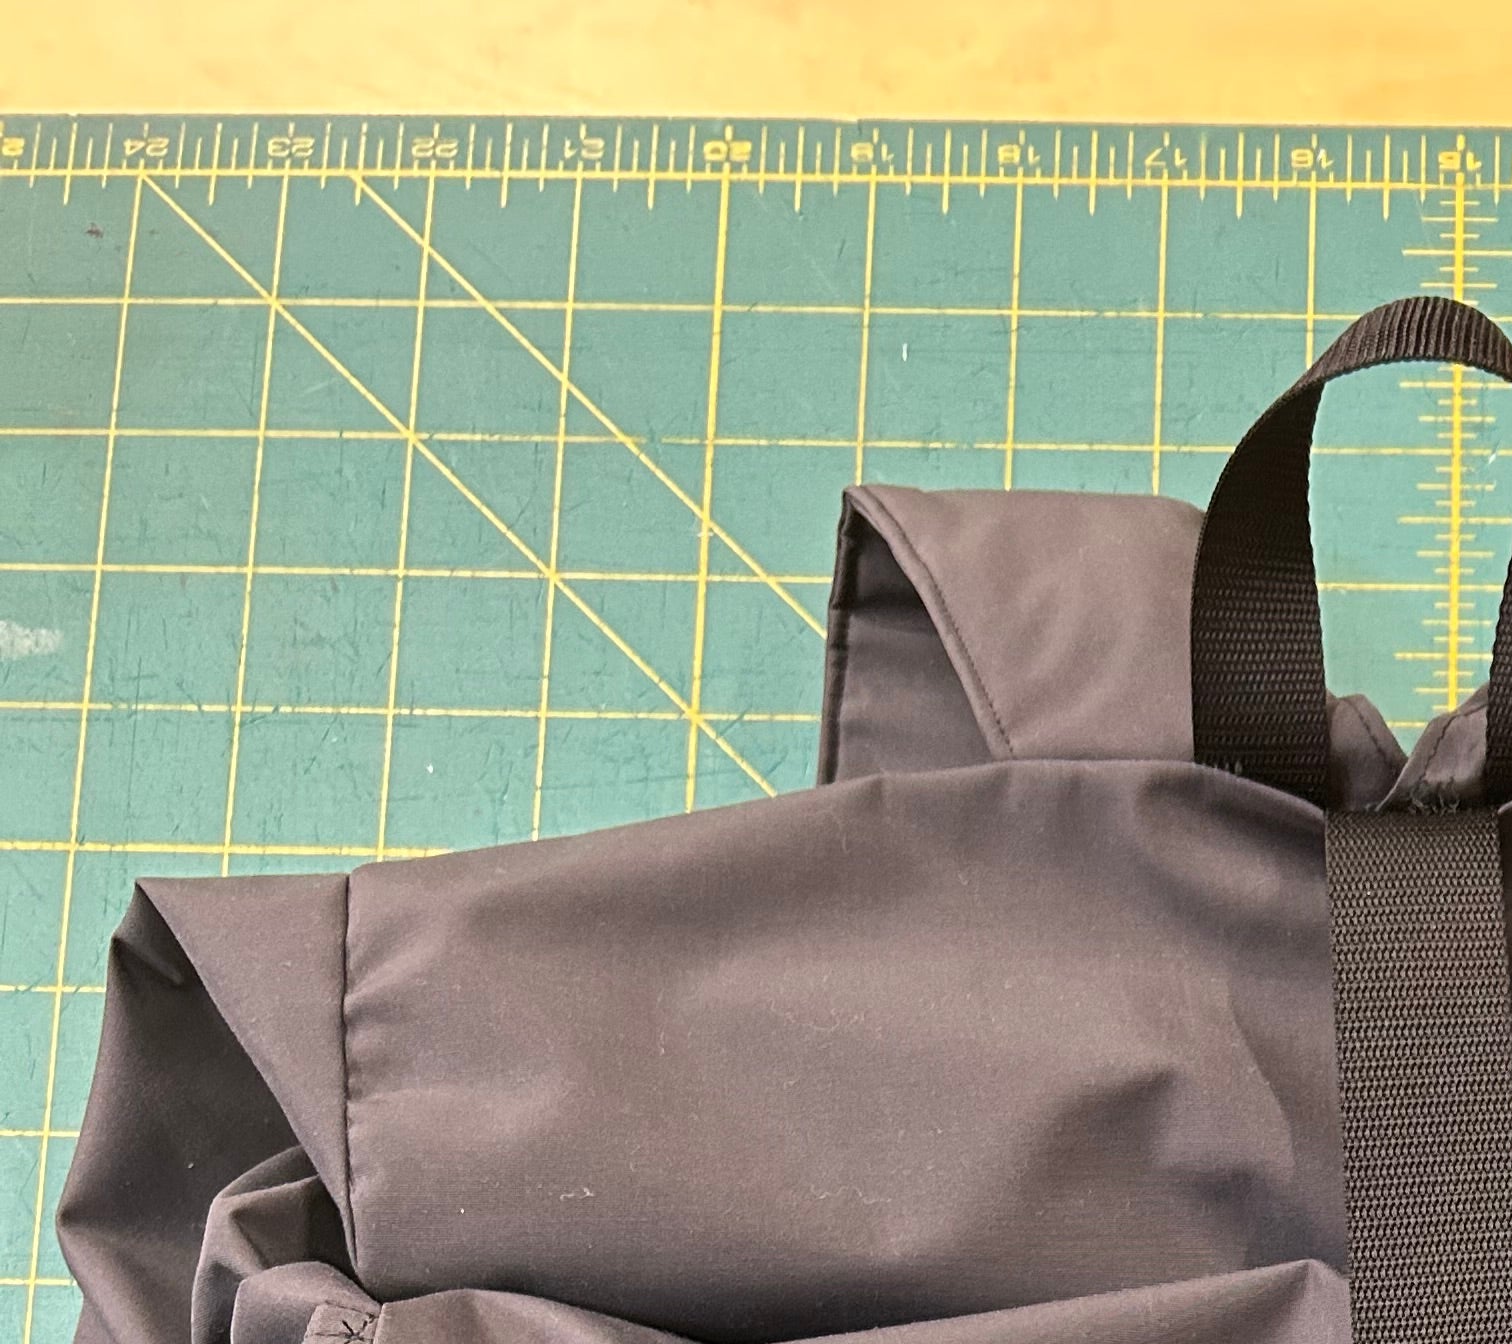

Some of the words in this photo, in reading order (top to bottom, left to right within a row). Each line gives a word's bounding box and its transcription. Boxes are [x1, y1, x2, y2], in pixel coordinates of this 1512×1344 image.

[123, 137, 170, 157] 24
[267, 137, 315, 157] 23
[411, 137, 458, 159] 22
[564, 137, 604, 159] 21
[1144, 147, 1187, 168] 17
[1291, 148, 1334, 169] 16
[1438, 151, 1482, 171] 15
